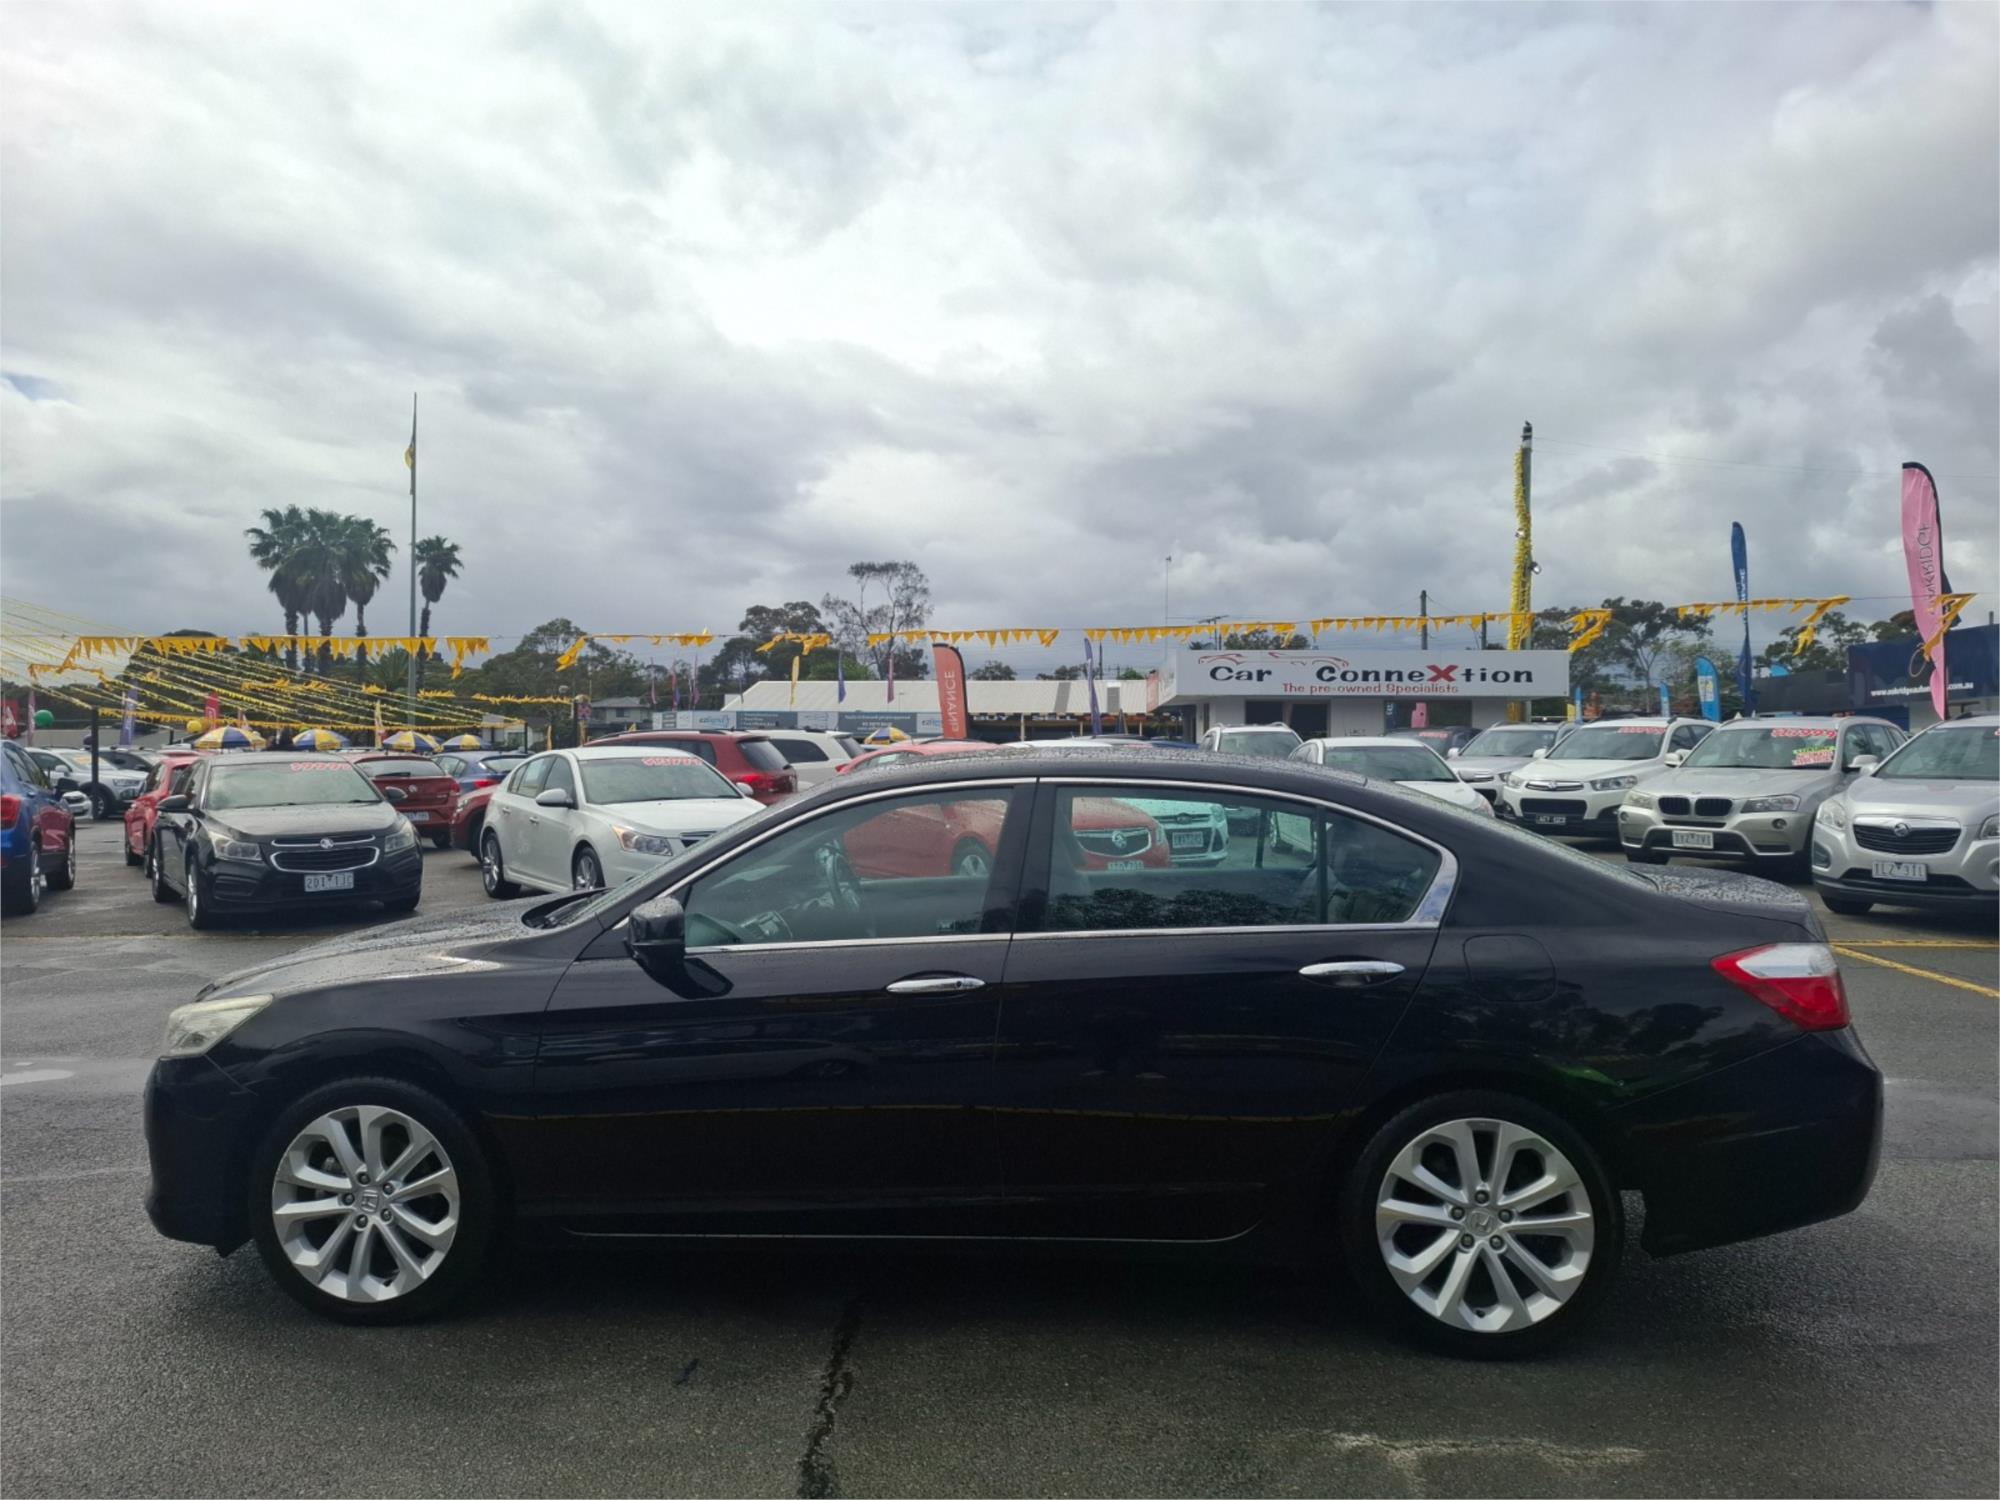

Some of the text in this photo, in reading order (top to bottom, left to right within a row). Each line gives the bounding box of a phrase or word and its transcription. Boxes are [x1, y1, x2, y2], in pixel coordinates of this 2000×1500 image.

[1209, 664, 1534, 683] Car ConneXtion
[1283, 682, 1459, 696] The pre-owned Specialists
